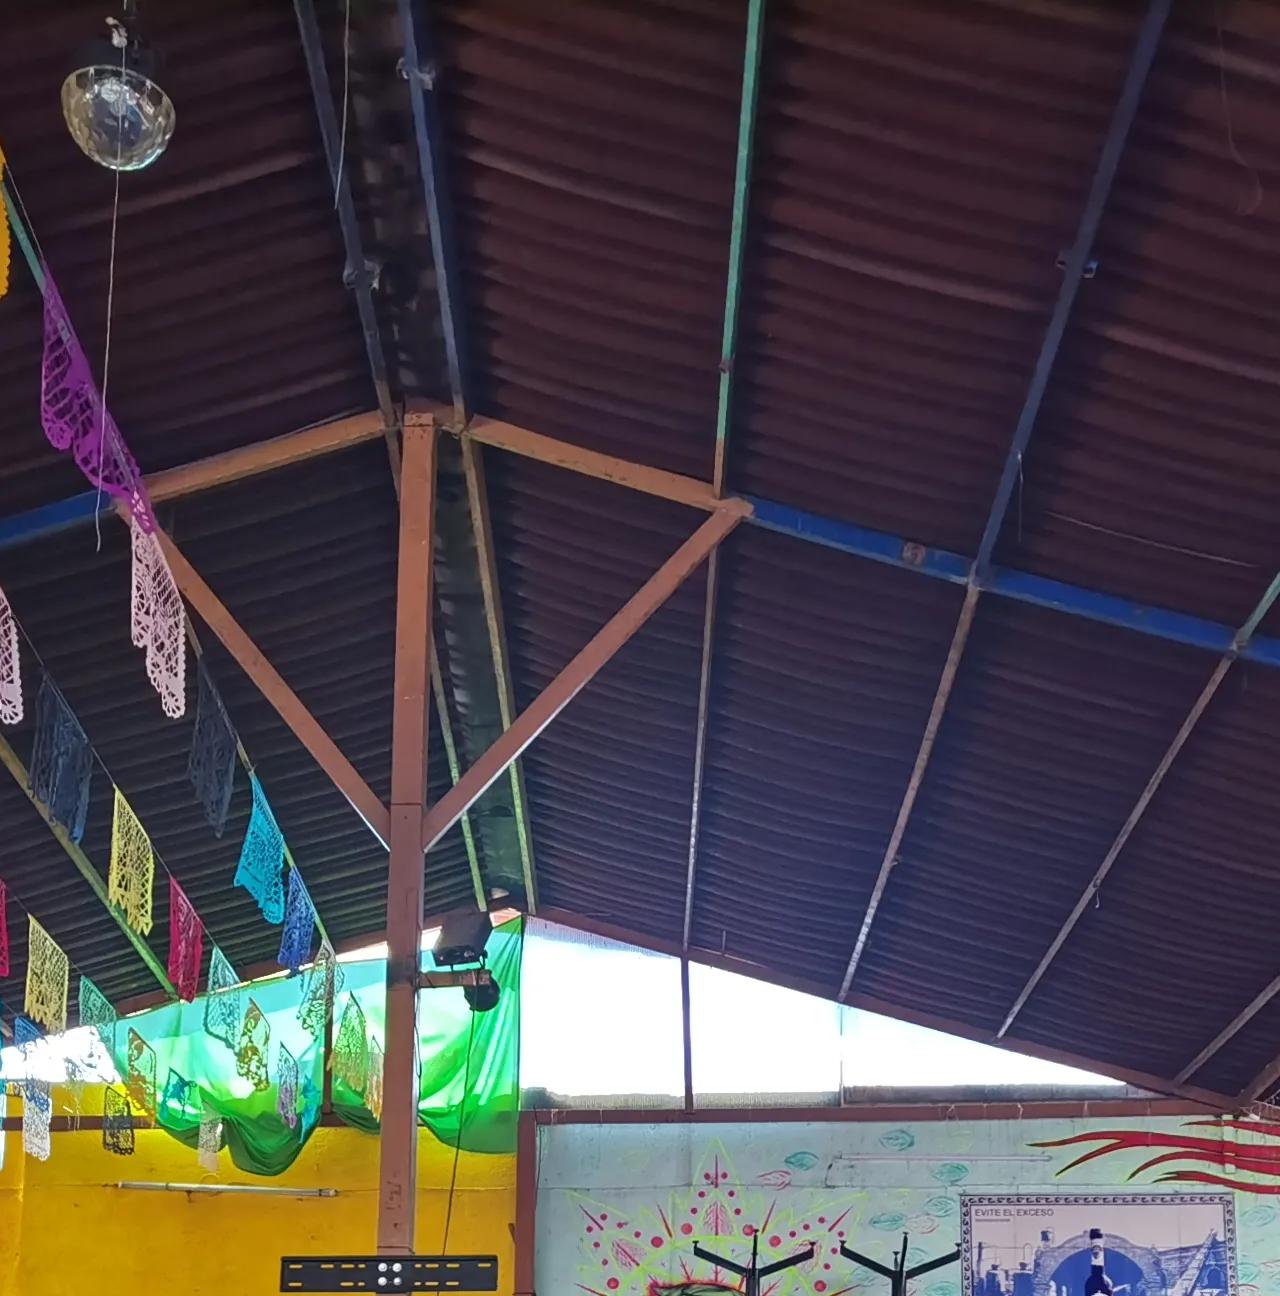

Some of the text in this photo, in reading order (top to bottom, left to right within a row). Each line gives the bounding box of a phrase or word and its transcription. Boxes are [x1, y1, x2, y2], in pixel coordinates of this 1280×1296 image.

[975, 1208, 1055, 1217] EVITE EL EXCESO
